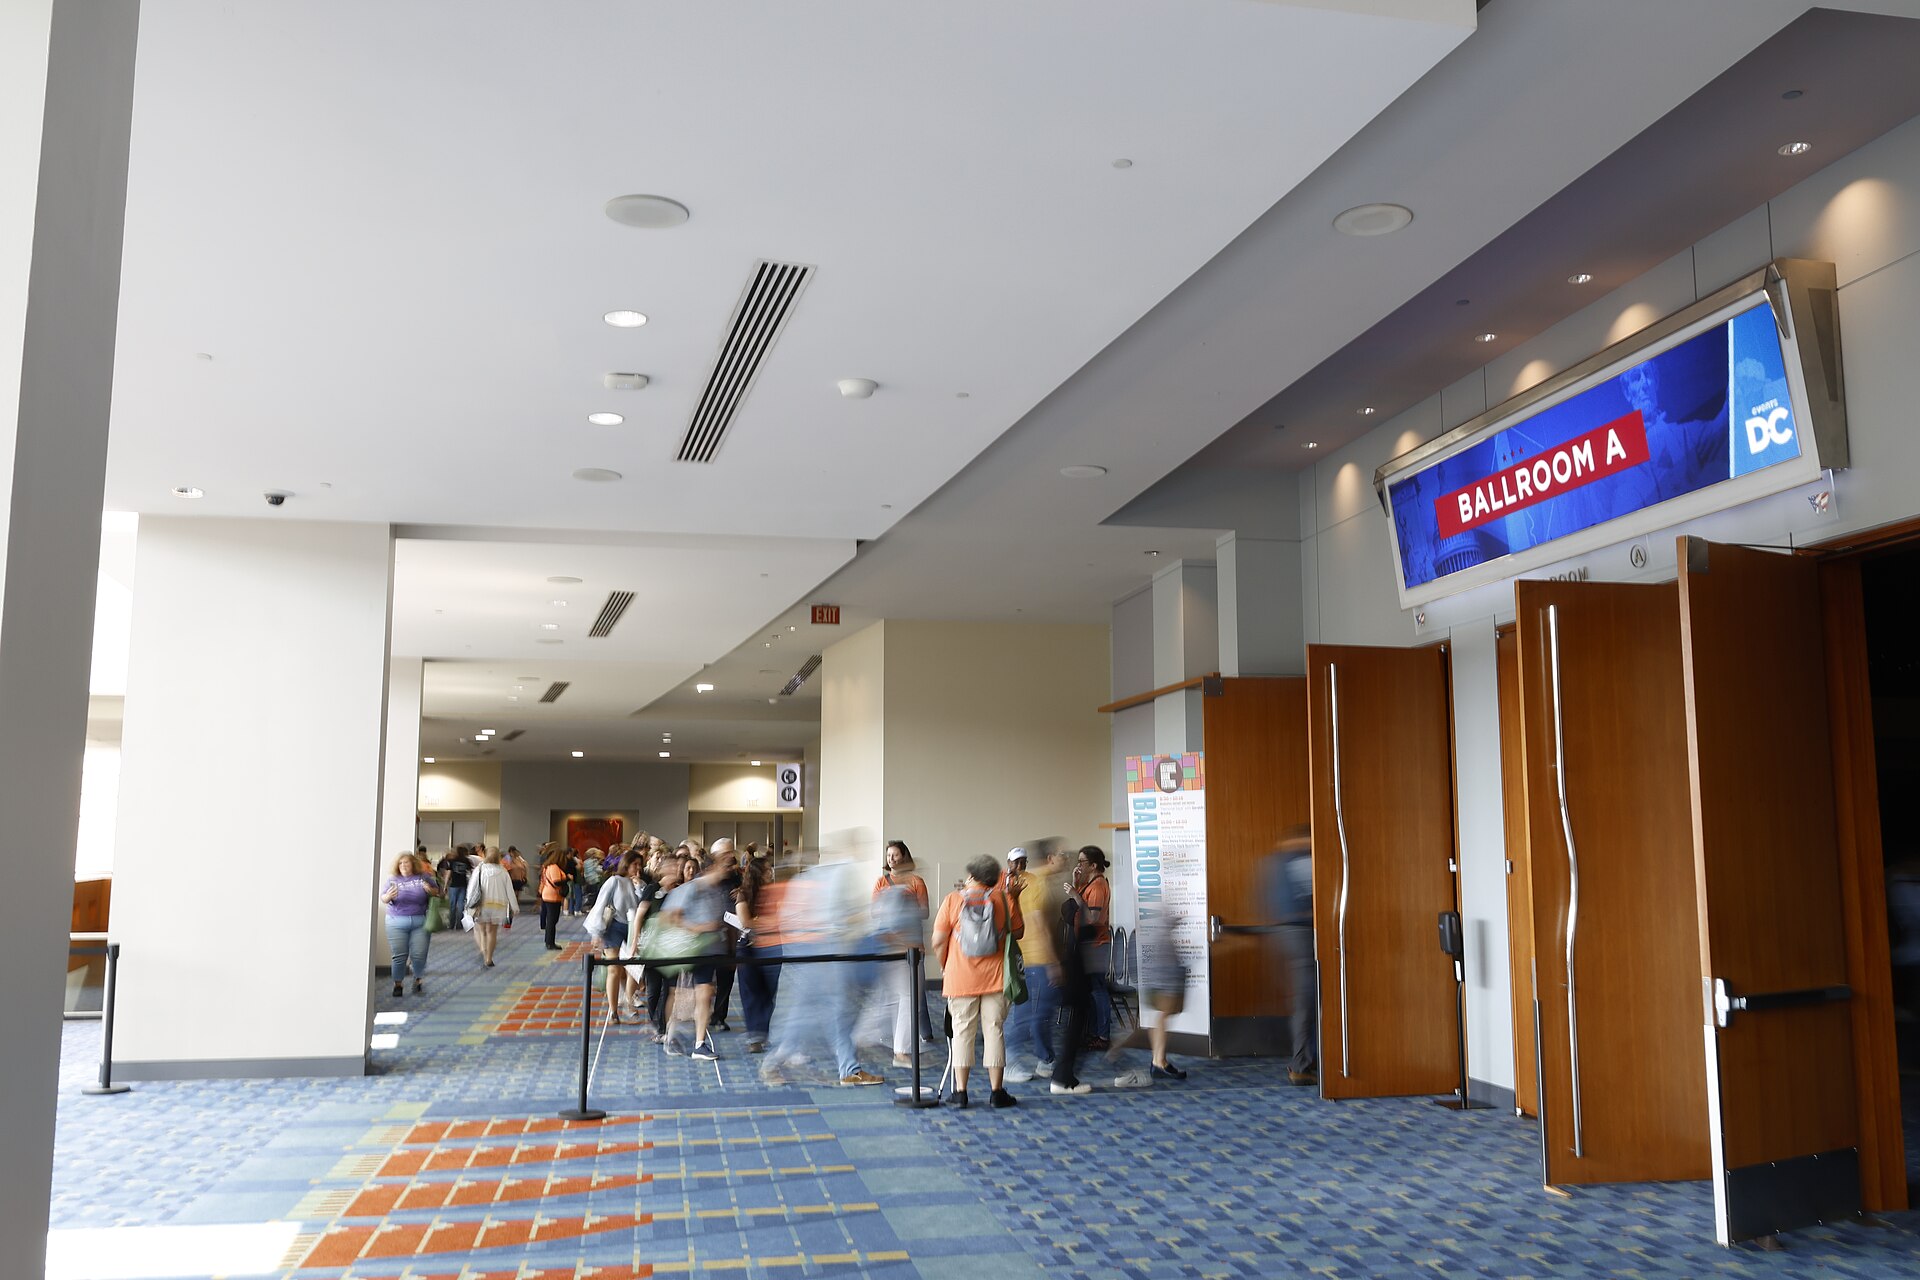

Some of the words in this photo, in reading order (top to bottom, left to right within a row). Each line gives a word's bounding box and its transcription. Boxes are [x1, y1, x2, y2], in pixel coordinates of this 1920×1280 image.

[1745, 407, 1792, 455] DC
[1457, 440, 1595, 524] BALLROOM
[1606, 428, 1626, 465] A
[816, 607, 837, 623] EXIT
[1132, 797, 1162, 903] BALLROOM
[1139, 907, 1162, 921] A
